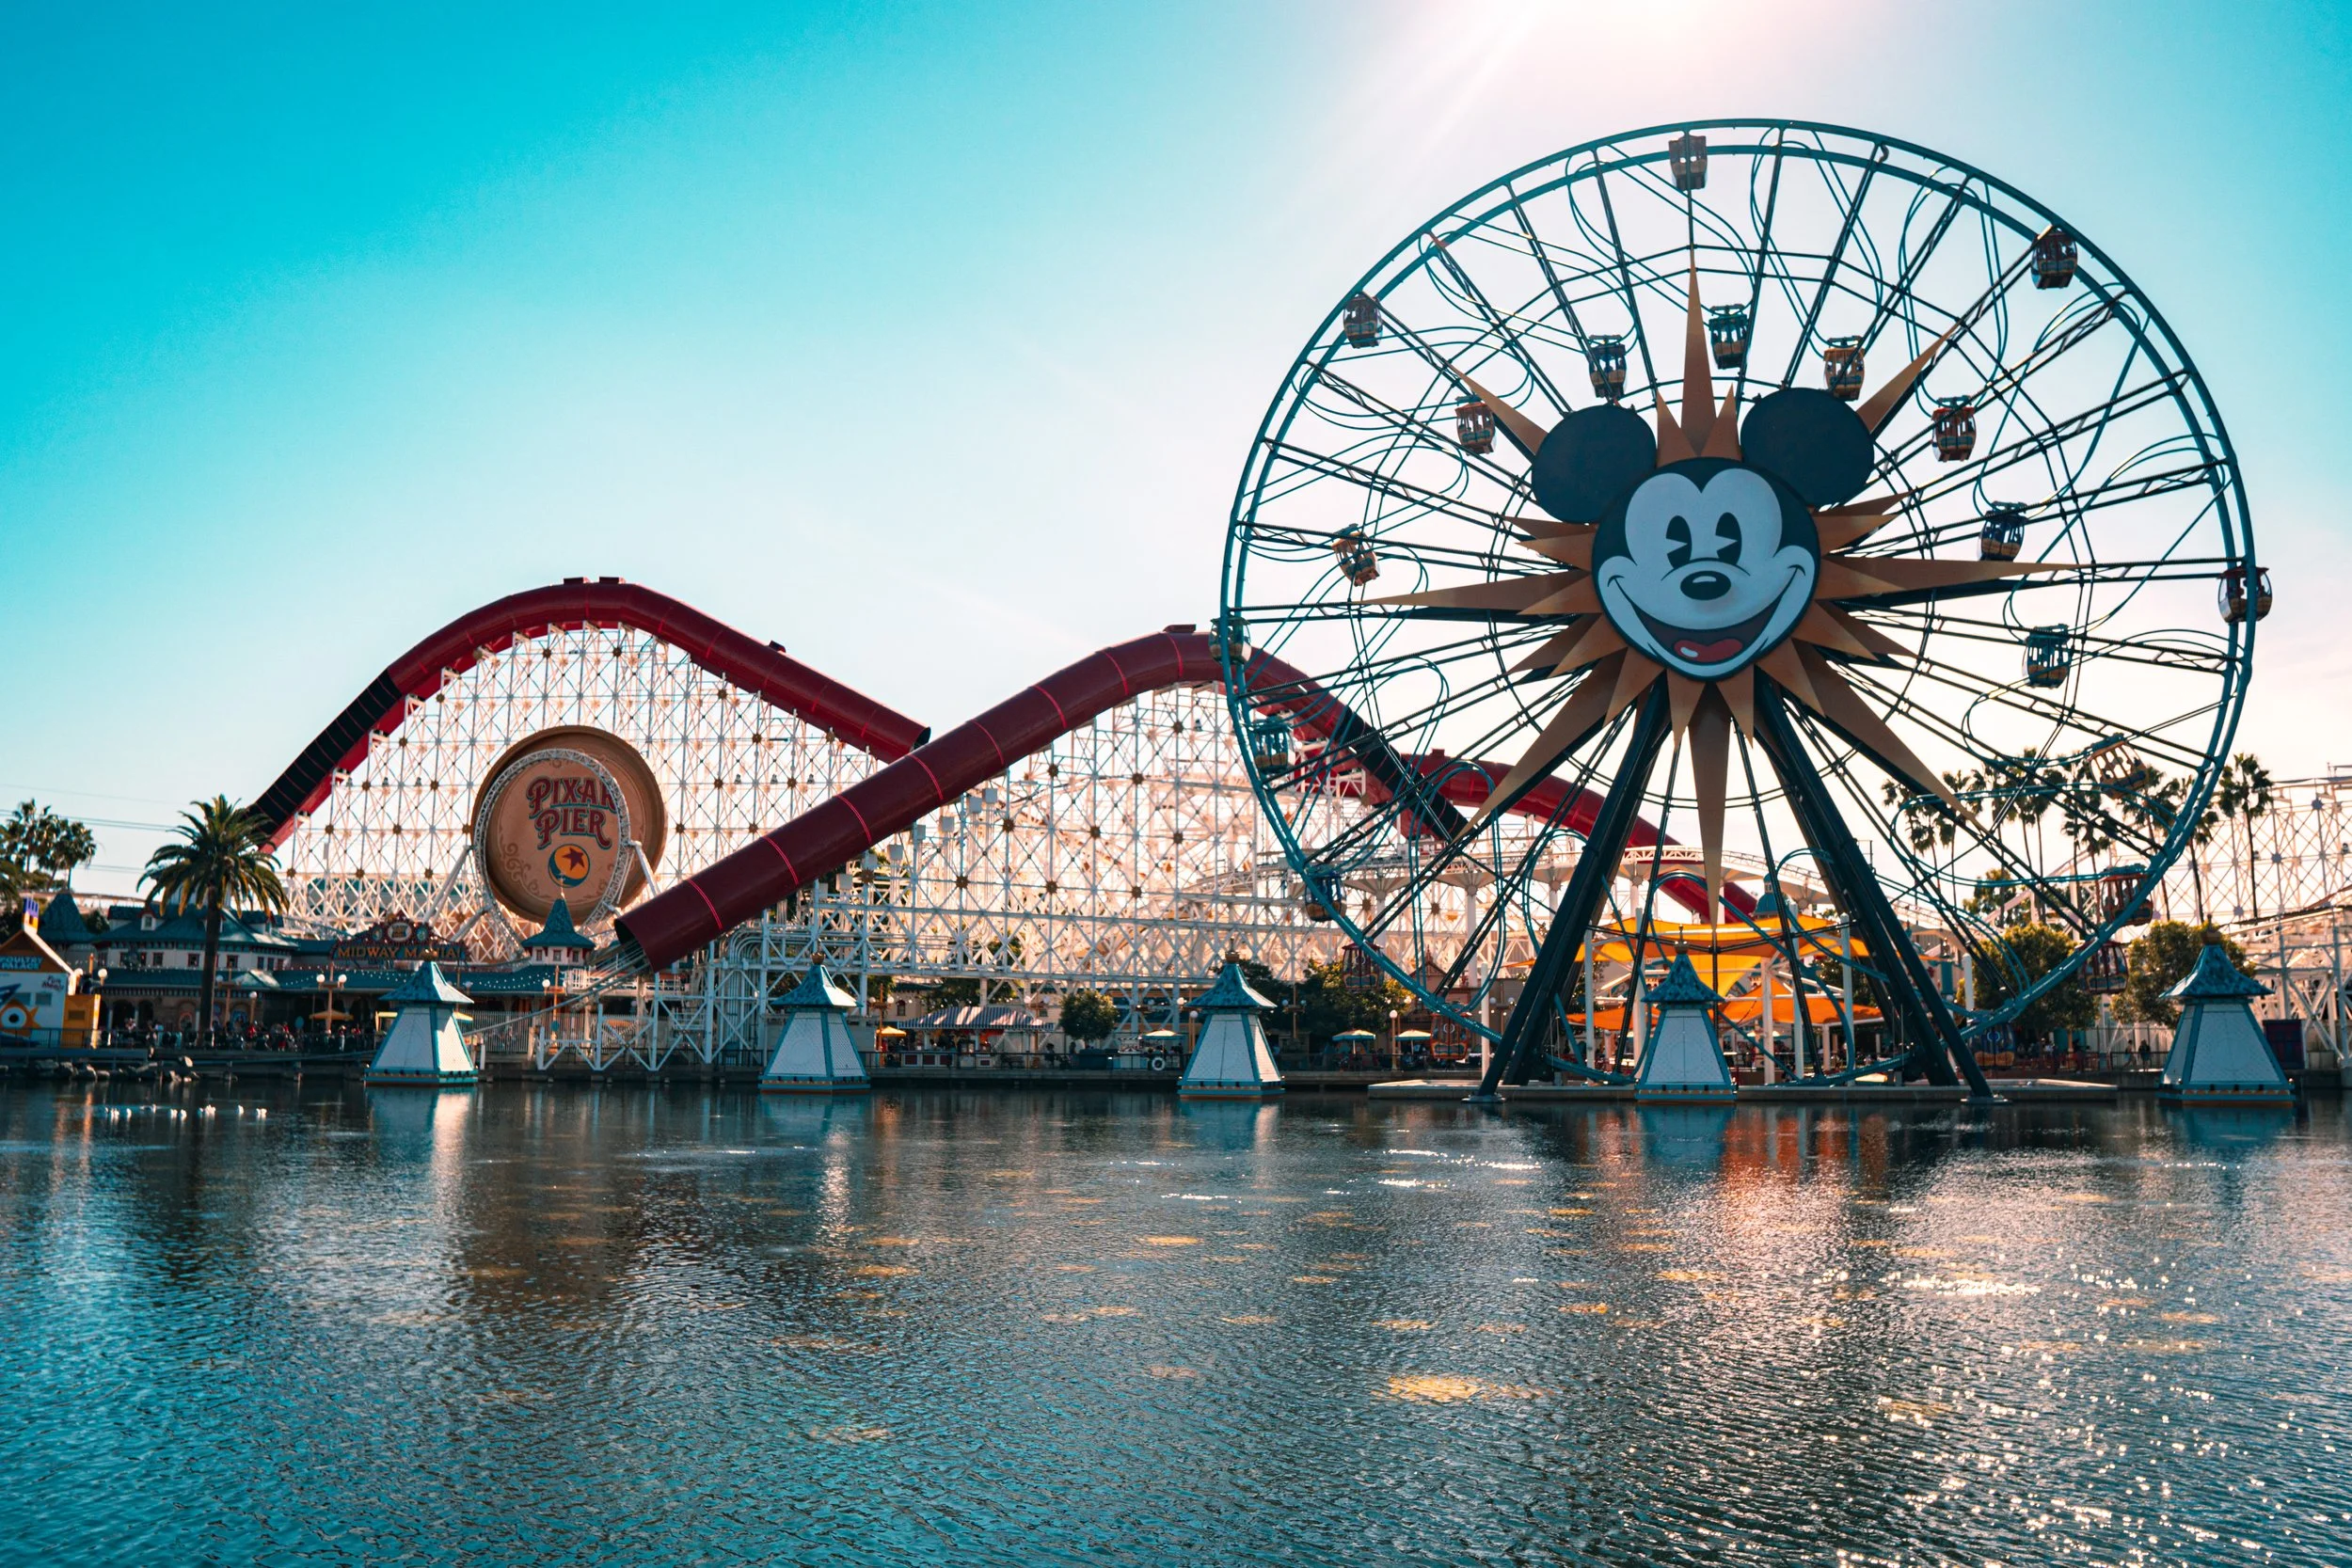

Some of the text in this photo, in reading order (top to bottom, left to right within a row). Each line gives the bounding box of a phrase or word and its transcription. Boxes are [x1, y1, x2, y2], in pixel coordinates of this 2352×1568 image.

[527, 777, 618, 819] PIXAR
[535, 808, 612, 850] PIER
[339, 946, 399, 958] MIDWAY
